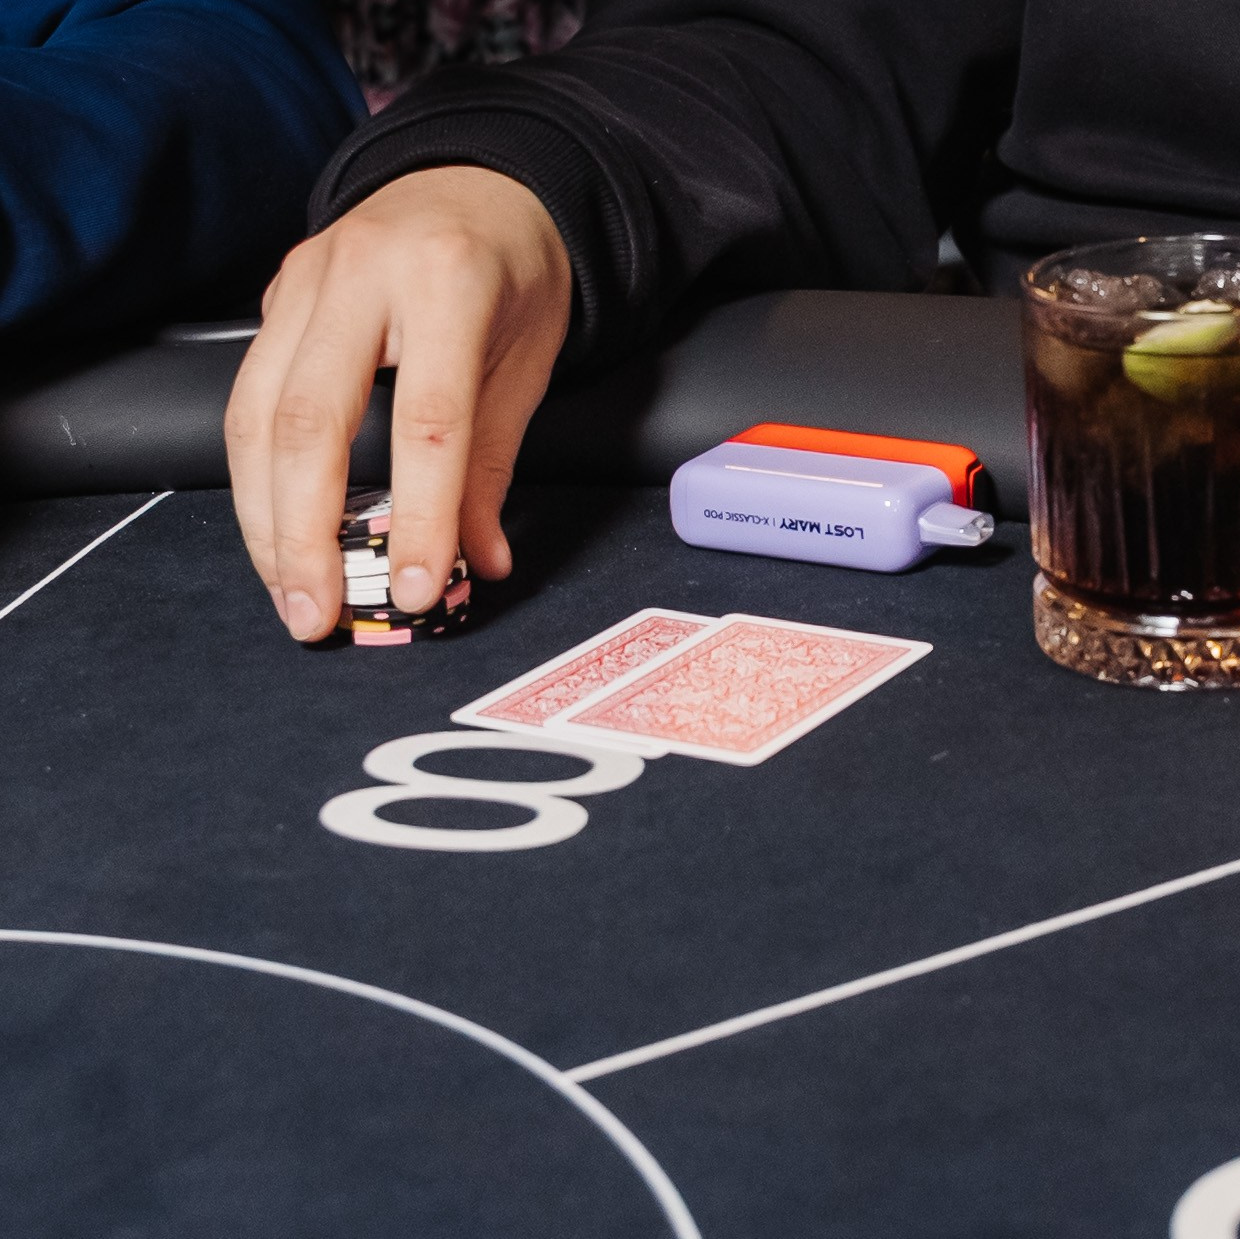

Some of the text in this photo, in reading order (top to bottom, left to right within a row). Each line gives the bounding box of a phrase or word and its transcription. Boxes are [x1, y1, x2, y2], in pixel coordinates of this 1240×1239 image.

[703, 509, 864, 539] LOST MARY X-CLASSIC POD
[318, 729, 646, 852] 8
